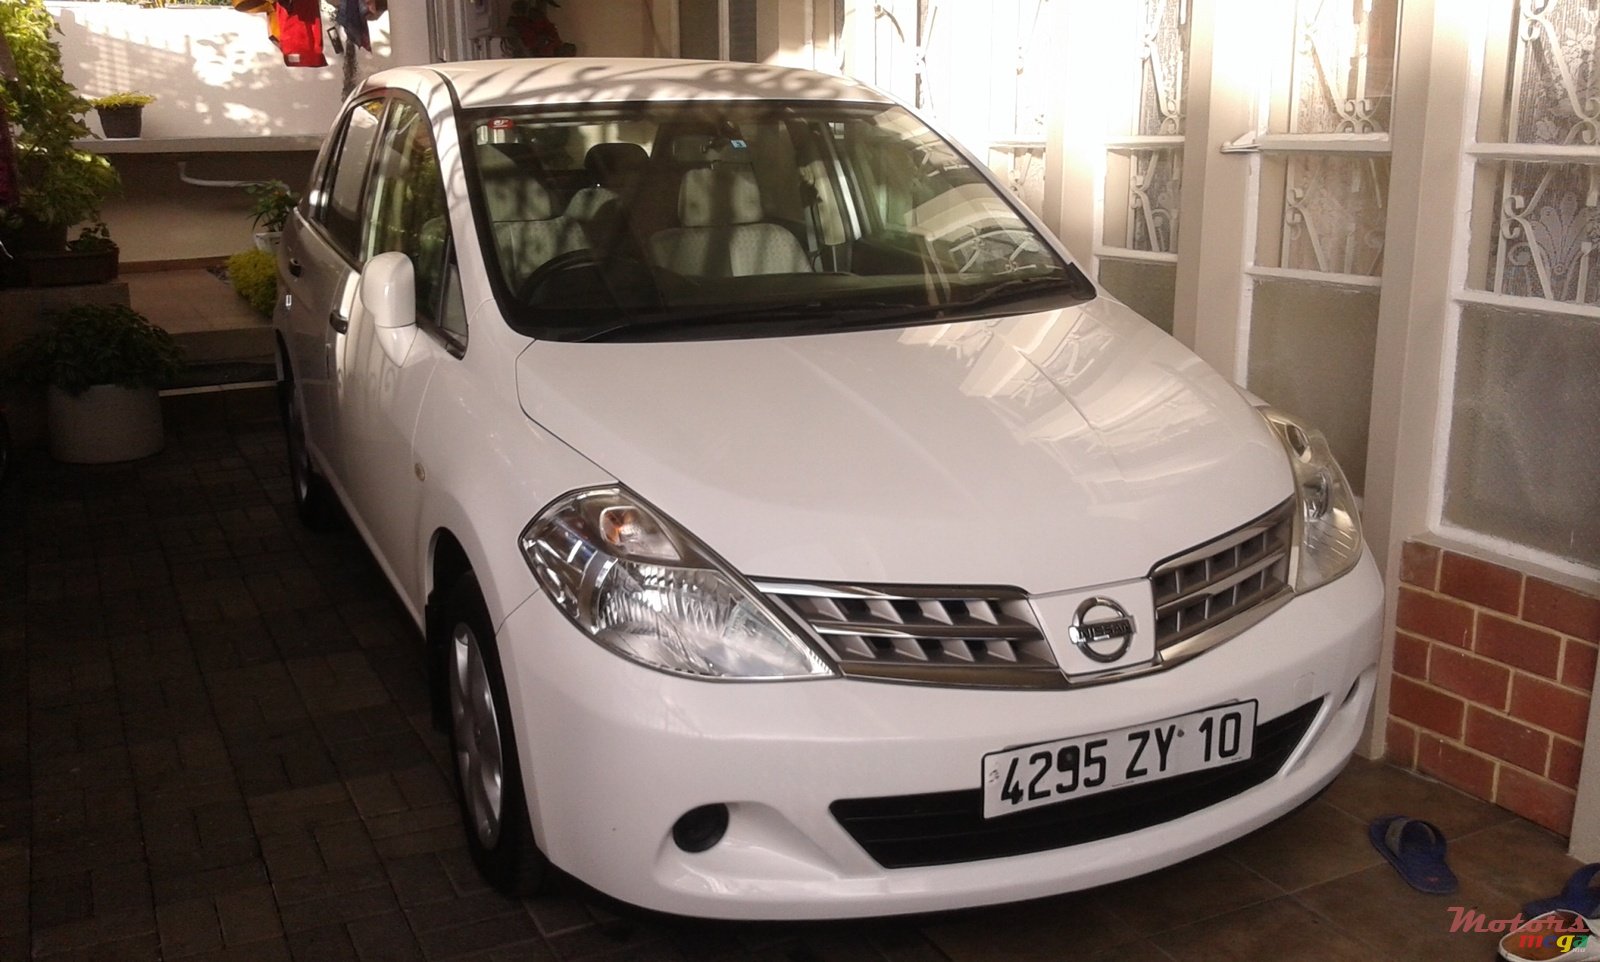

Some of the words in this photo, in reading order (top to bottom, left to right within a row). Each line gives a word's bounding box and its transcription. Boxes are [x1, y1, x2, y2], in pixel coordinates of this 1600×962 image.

[1000, 739, 1107, 805] 4295
[1126, 724, 1176, 779] ZY
[1199, 712, 1242, 762] 10
